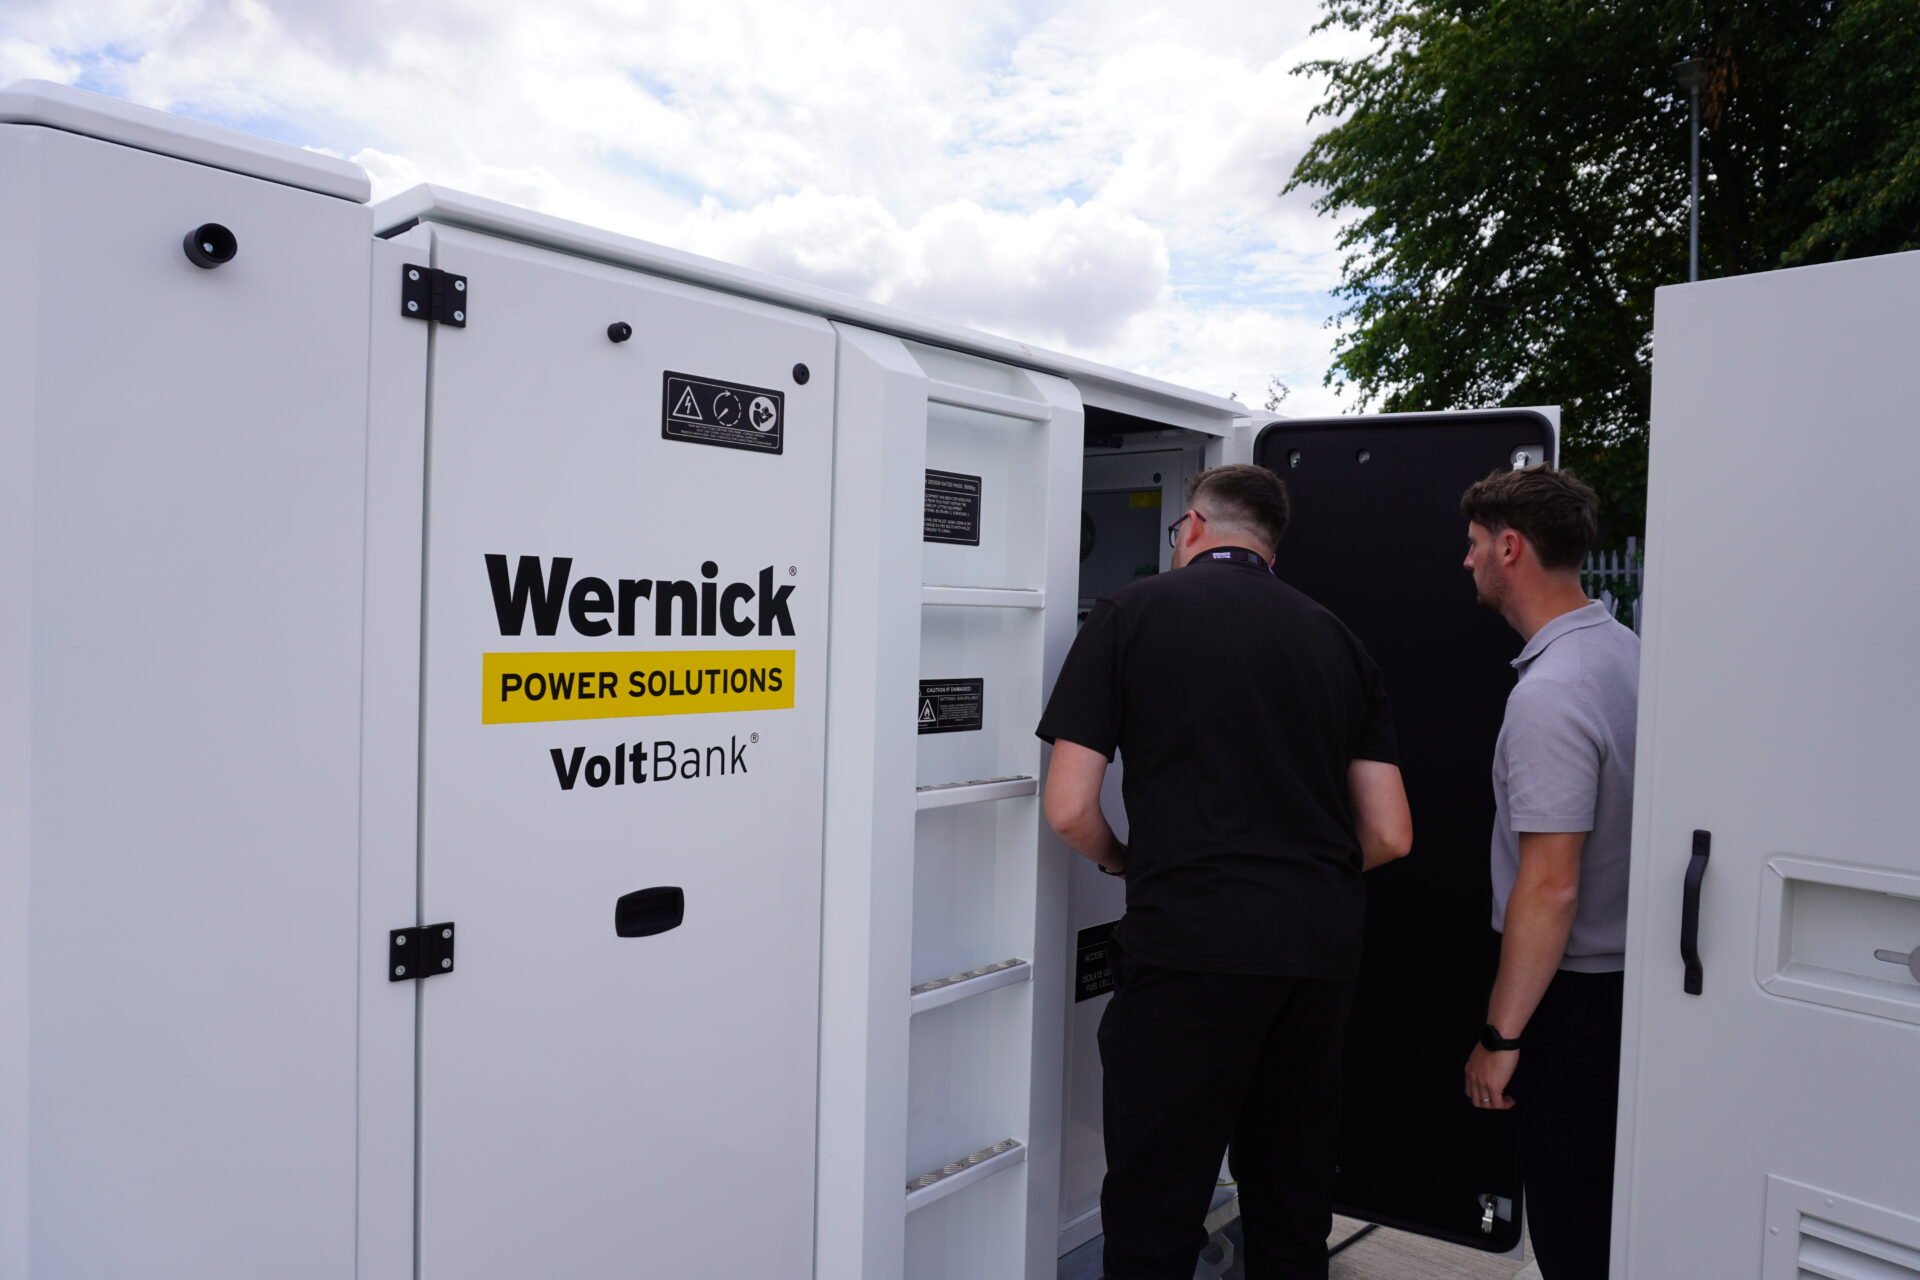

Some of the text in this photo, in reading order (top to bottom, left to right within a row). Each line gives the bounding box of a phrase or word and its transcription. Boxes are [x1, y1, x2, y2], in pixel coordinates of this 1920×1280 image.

[484, 553, 796, 637] Wernick
[501, 667, 783, 702] POWER SOLUTIONS
